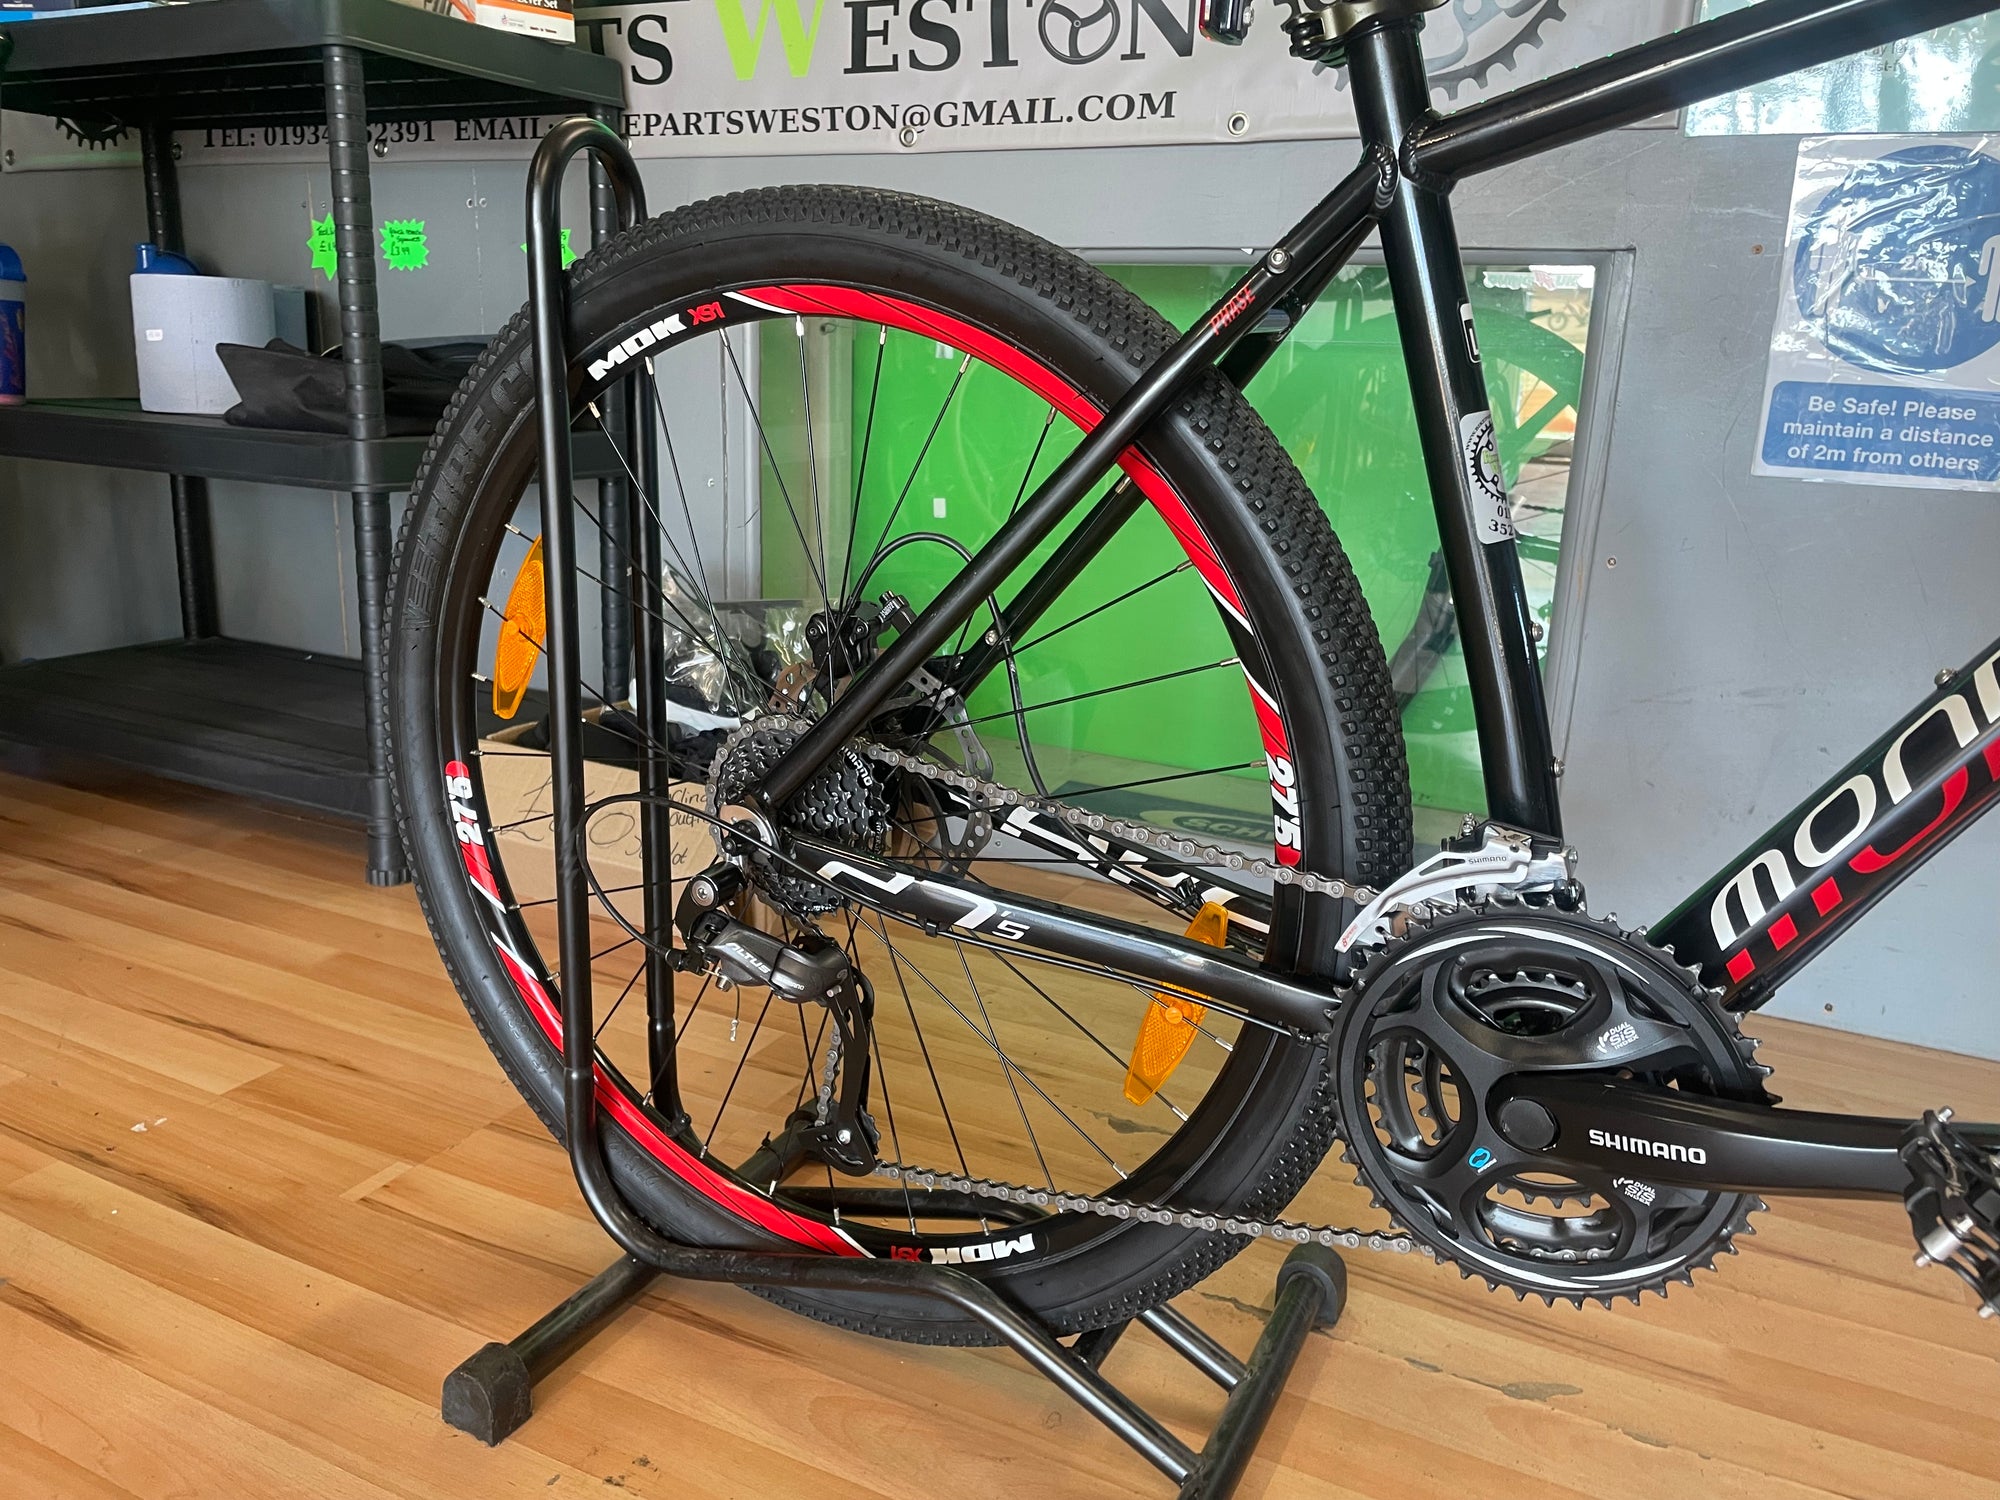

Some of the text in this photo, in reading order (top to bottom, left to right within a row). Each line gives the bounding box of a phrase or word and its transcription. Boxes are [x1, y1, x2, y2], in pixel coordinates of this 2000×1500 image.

[711, 0, 1195, 81] WESTON
[203, 126, 255, 148] TEL:
[366, 120, 436, 144] 2391
[623, 91, 1178, 138] EPARTSWESTON@GMAIL.COM
[1209, 286, 1256, 336] PHASE
[1808, 396, 1977, 421] Be Safe! Please
[1783, 421, 1994, 447] maintain a distance
[1787, 444, 1980, 472] of 2m from others
[1467, 856, 1507, 865] SHIMANO
[724, 942, 771, 974] ALTUS
[1610, 1022, 1631, 1036] DUAL
[1614, 1034, 1640, 1050] INDEX
[1589, 1129, 1707, 1165] SHIMANO
[1634, 1181, 1655, 1194] DUAL
